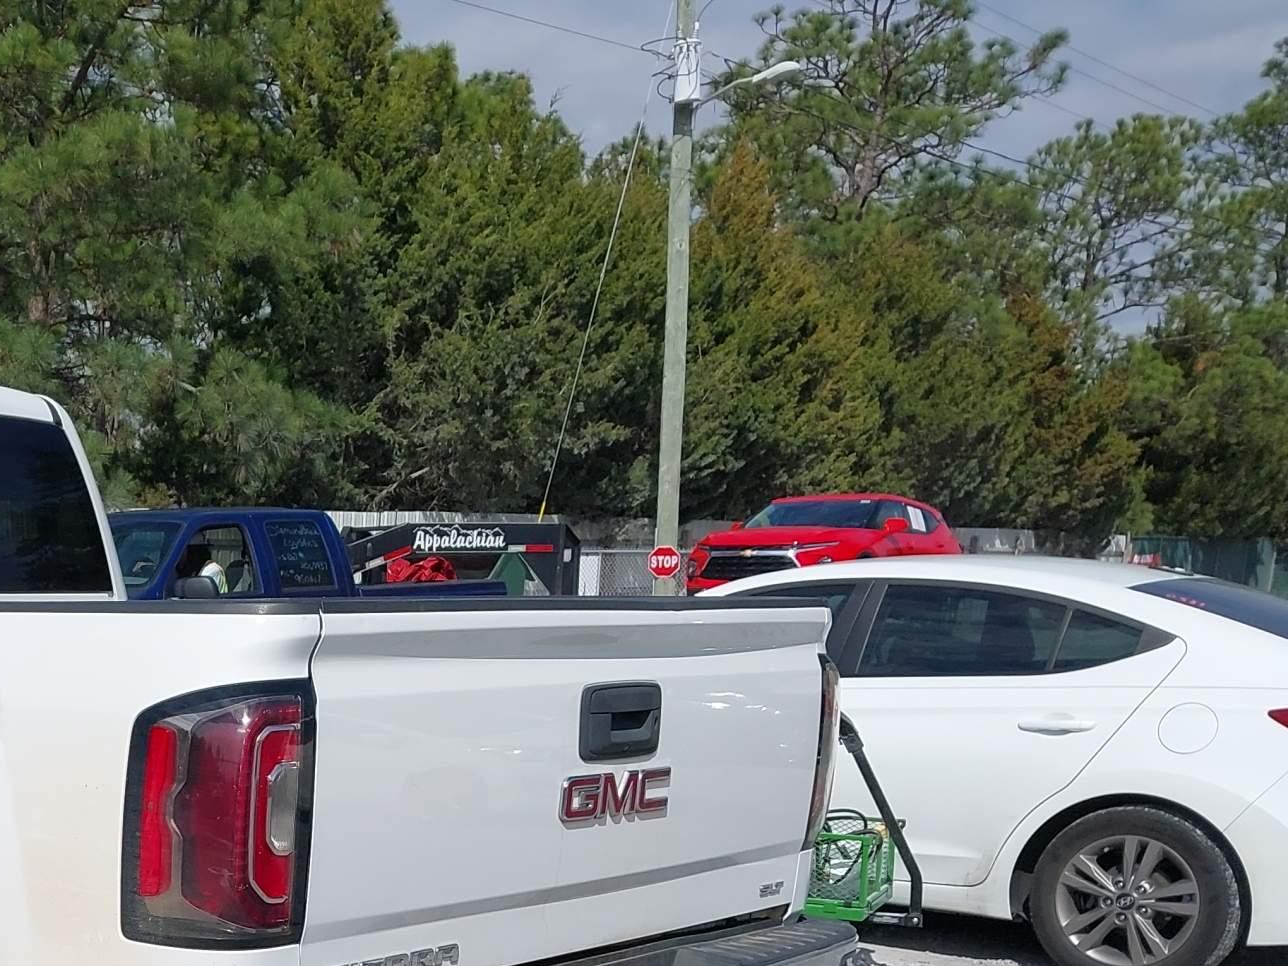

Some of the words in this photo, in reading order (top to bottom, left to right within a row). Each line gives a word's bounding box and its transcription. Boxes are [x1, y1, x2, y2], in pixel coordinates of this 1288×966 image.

[413, 530, 506, 551] Appalachian
[650, 556, 679, 569] STOP
[559, 767, 671, 830] GMC
